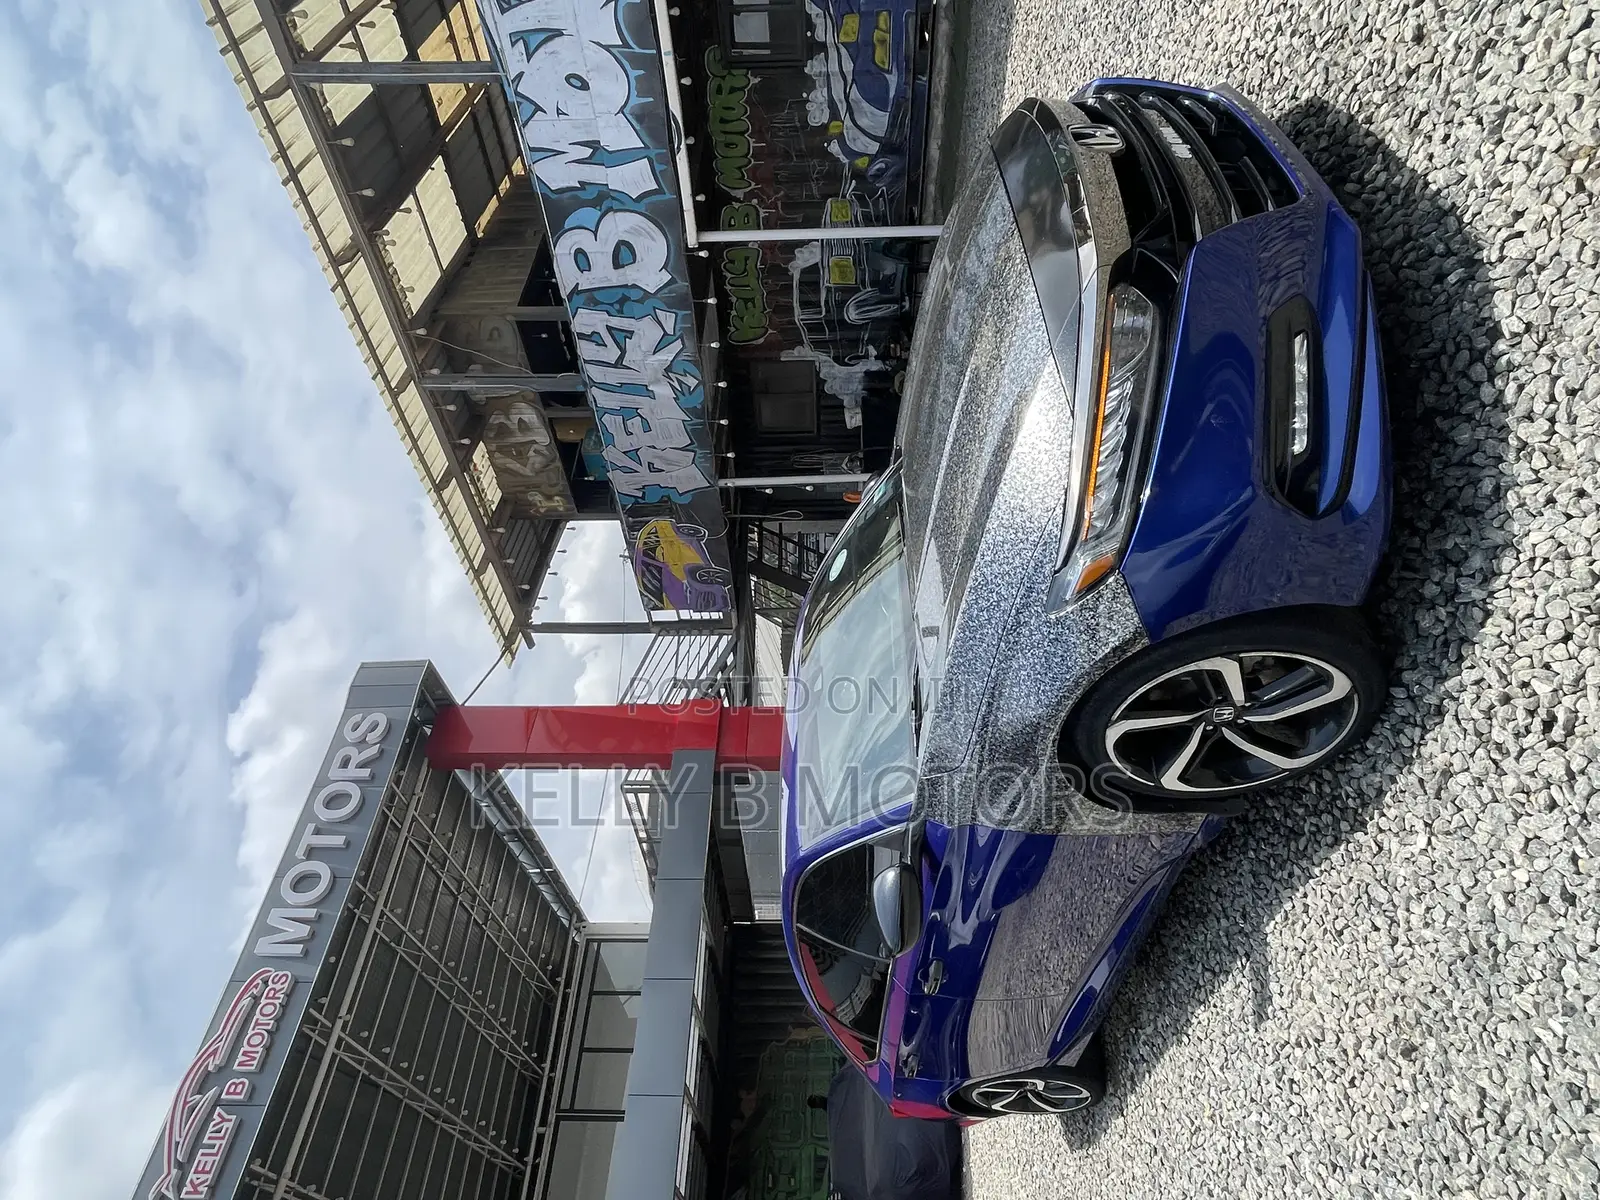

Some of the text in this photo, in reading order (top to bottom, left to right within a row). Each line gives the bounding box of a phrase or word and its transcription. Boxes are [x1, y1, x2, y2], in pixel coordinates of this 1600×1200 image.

[553, 206, 673, 298] B
[721, 202, 764, 231] B
[722, 246, 770, 343] KELLY
[570, 307, 711, 497] KELLY
[254, 711, 390, 957] MOTORS
[180, 969, 293, 1198] KELLY B MOTORS
